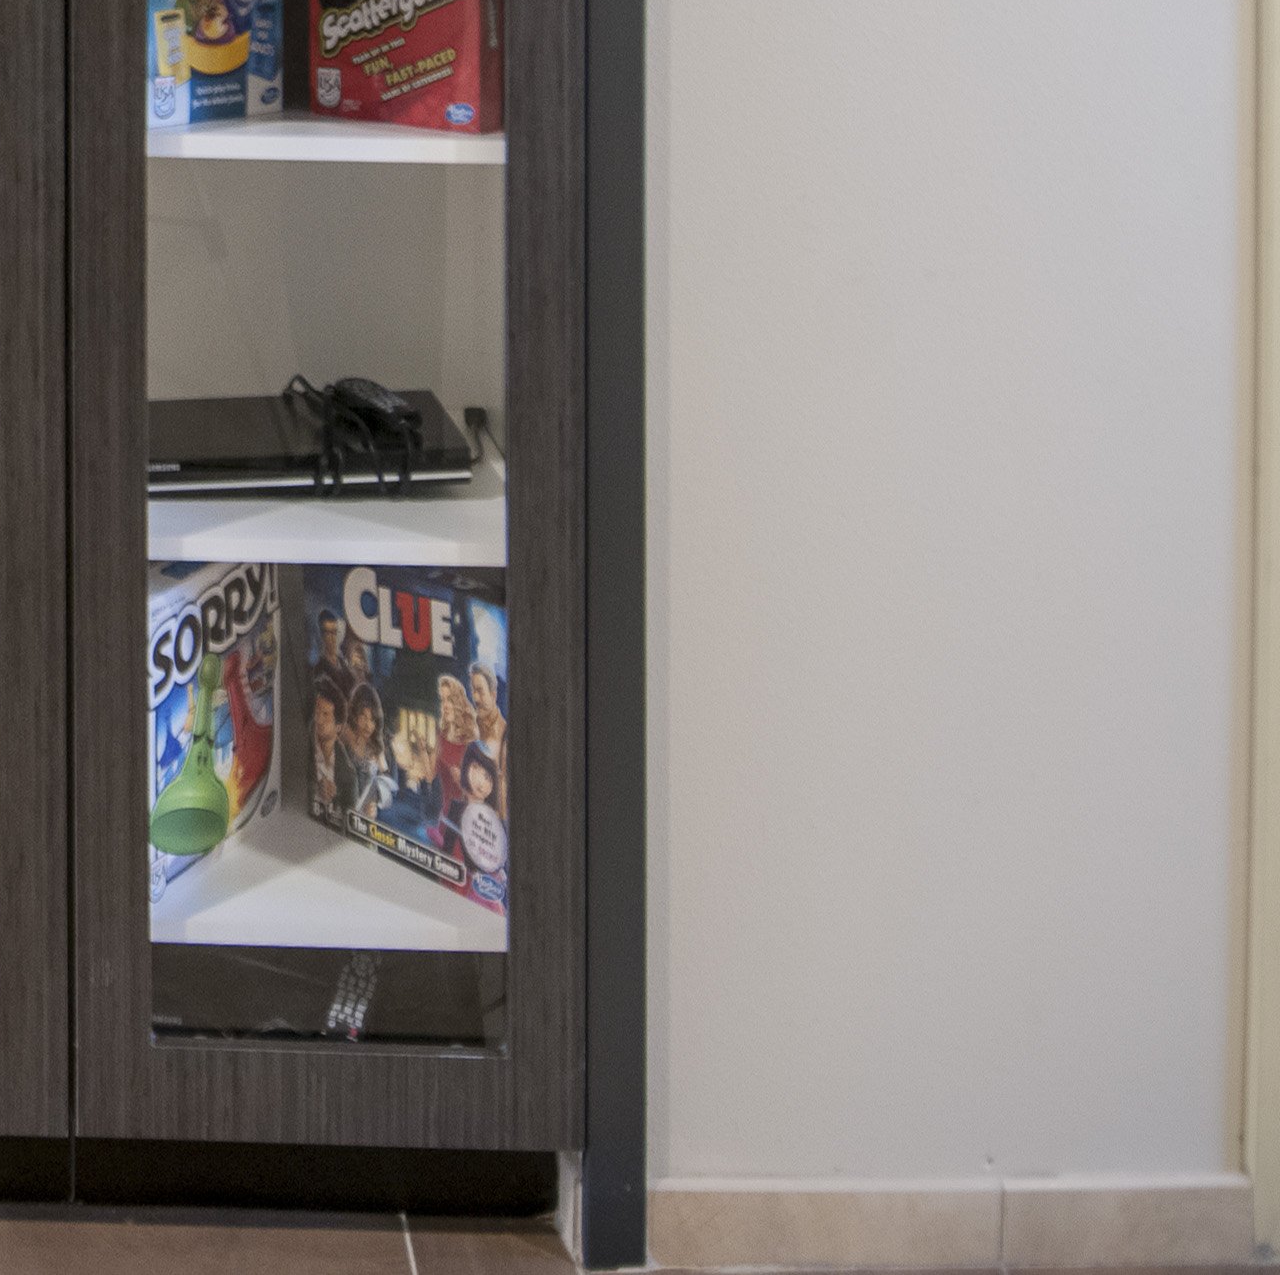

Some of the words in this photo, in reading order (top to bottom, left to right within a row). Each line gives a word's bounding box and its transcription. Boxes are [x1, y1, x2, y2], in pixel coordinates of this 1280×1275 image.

[343, 566, 454, 658] CLUE
[353, 815, 368, 835] The
[397, 837, 433, 868] Mystery
